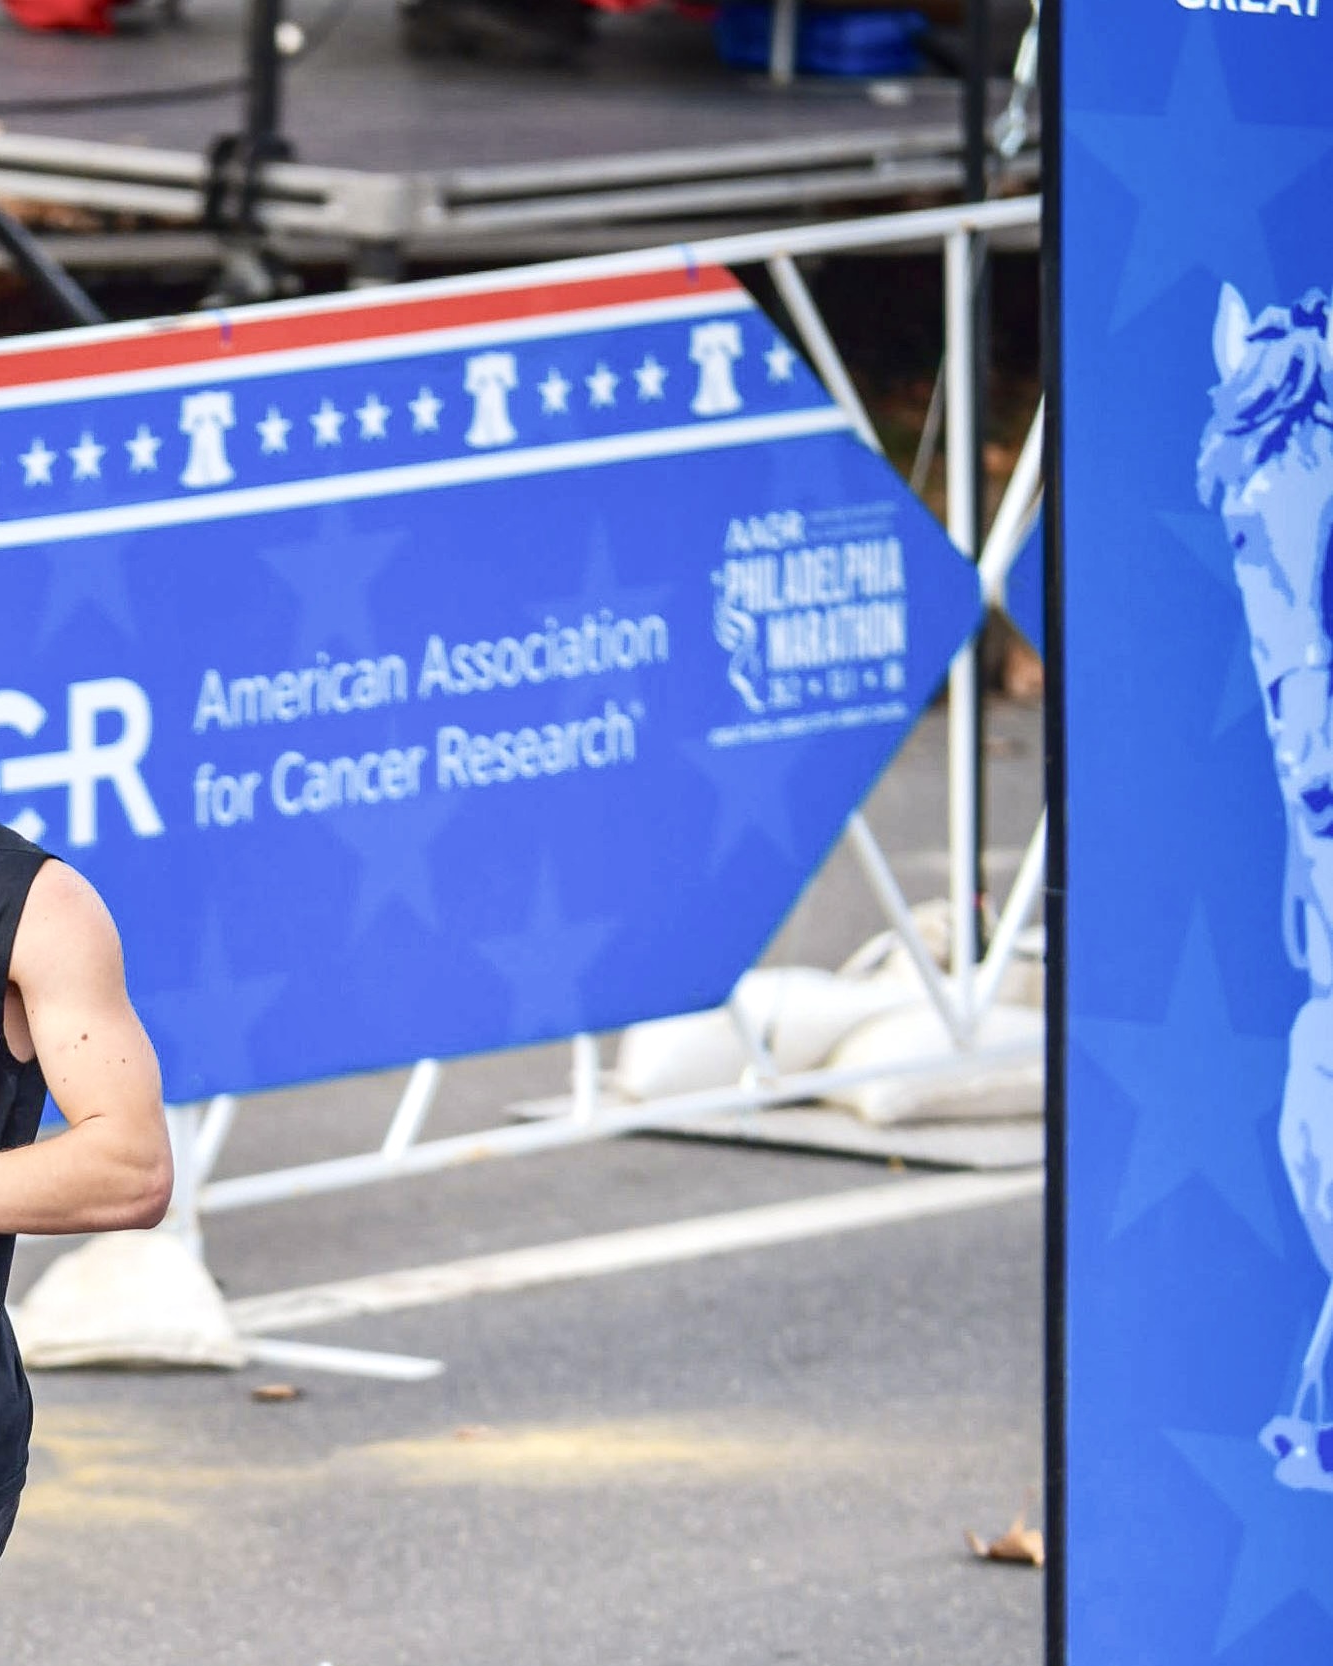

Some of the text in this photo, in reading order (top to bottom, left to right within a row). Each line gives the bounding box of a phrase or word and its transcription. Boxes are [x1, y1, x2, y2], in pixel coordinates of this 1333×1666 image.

[192, 650, 408, 733] American
[417, 607, 668, 698] Association
[193, 762, 262, 828] for
[271, 745, 428, 817] Cancer
